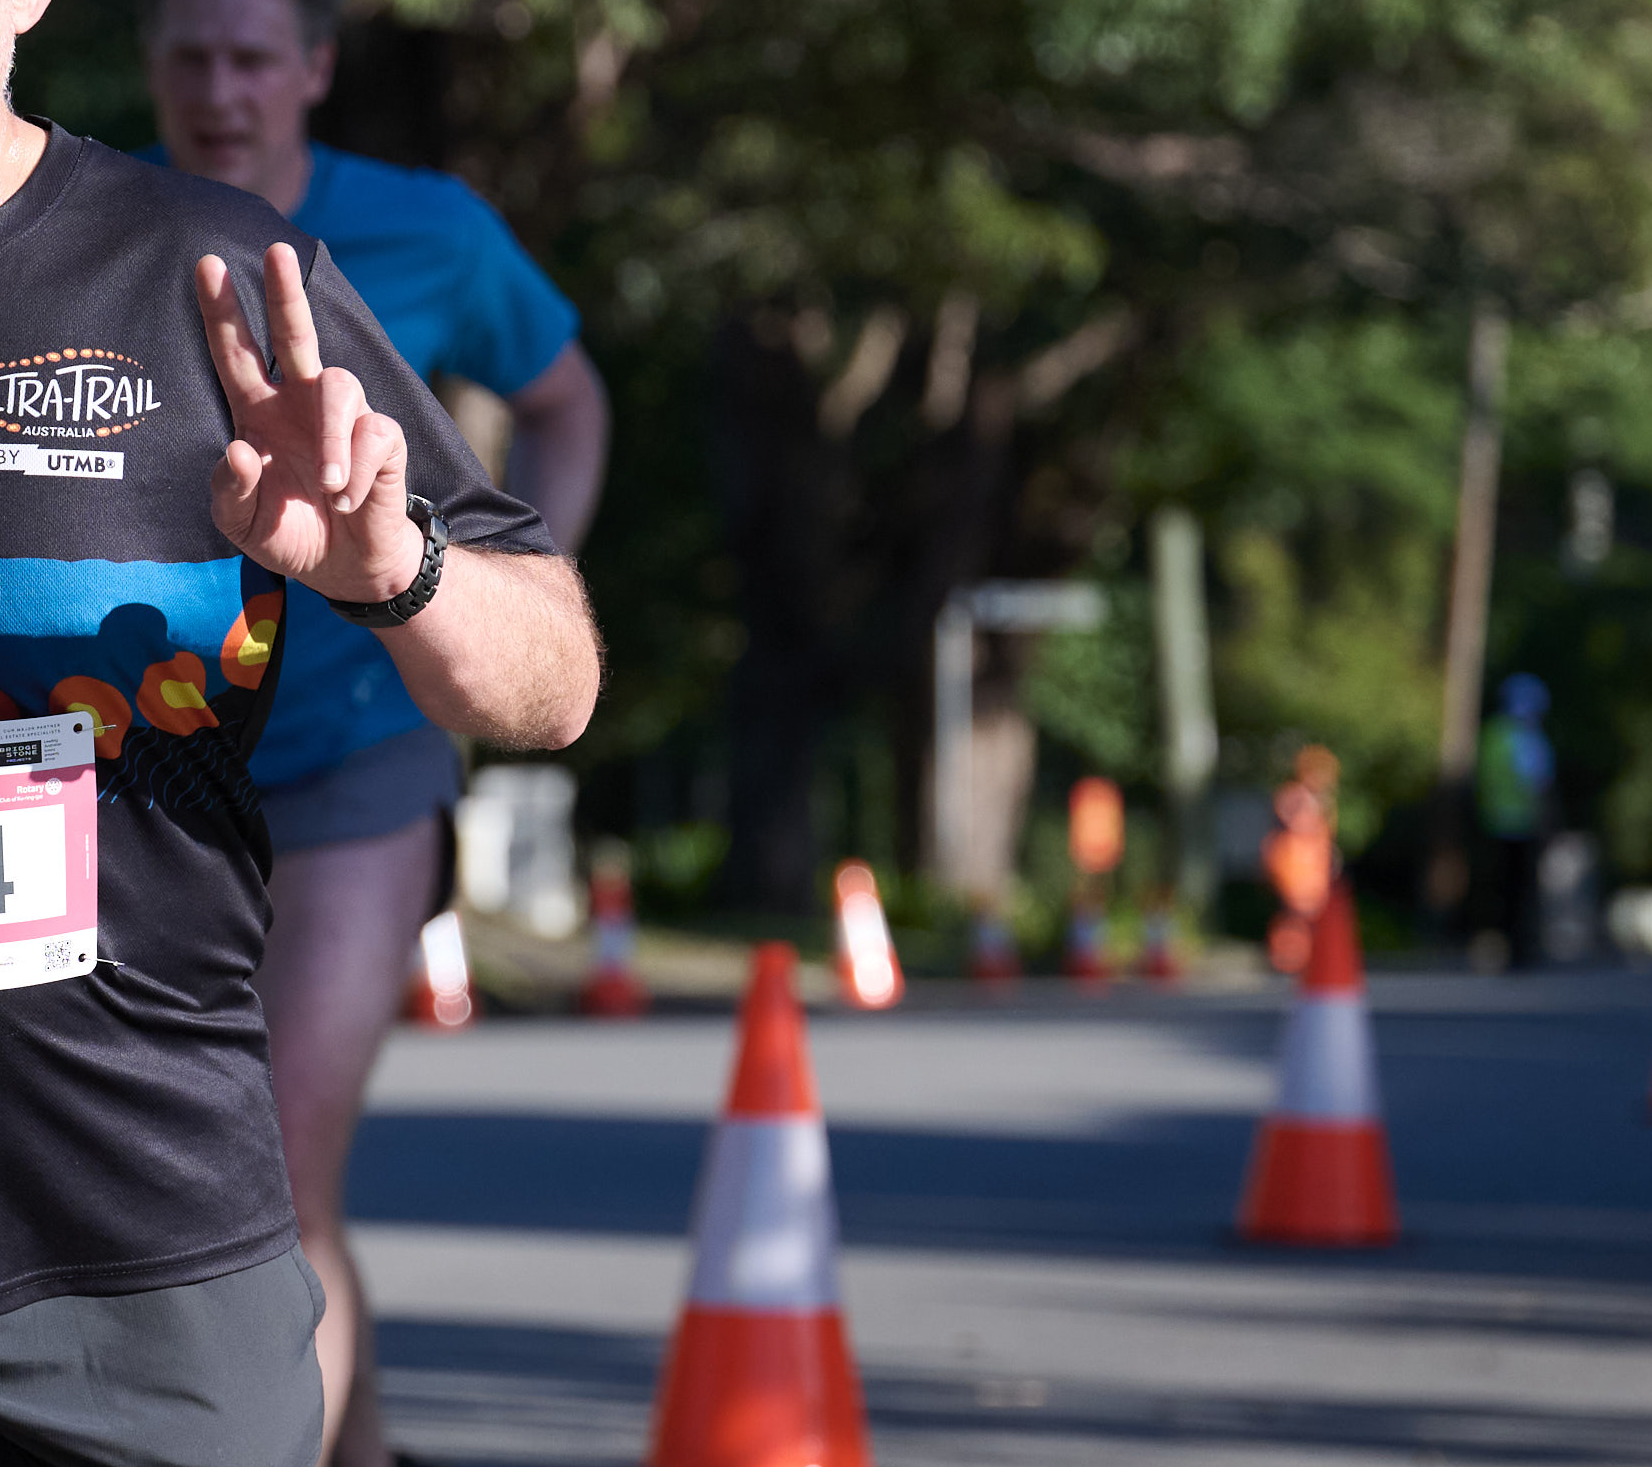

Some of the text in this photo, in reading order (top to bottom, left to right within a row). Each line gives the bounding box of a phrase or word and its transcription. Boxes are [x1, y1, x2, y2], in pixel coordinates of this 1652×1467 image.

[22, 425, 95, 438] AUSTRALIA
[6, 750, 38, 758] STONE
[16, 784, 44, 795] Rotary
